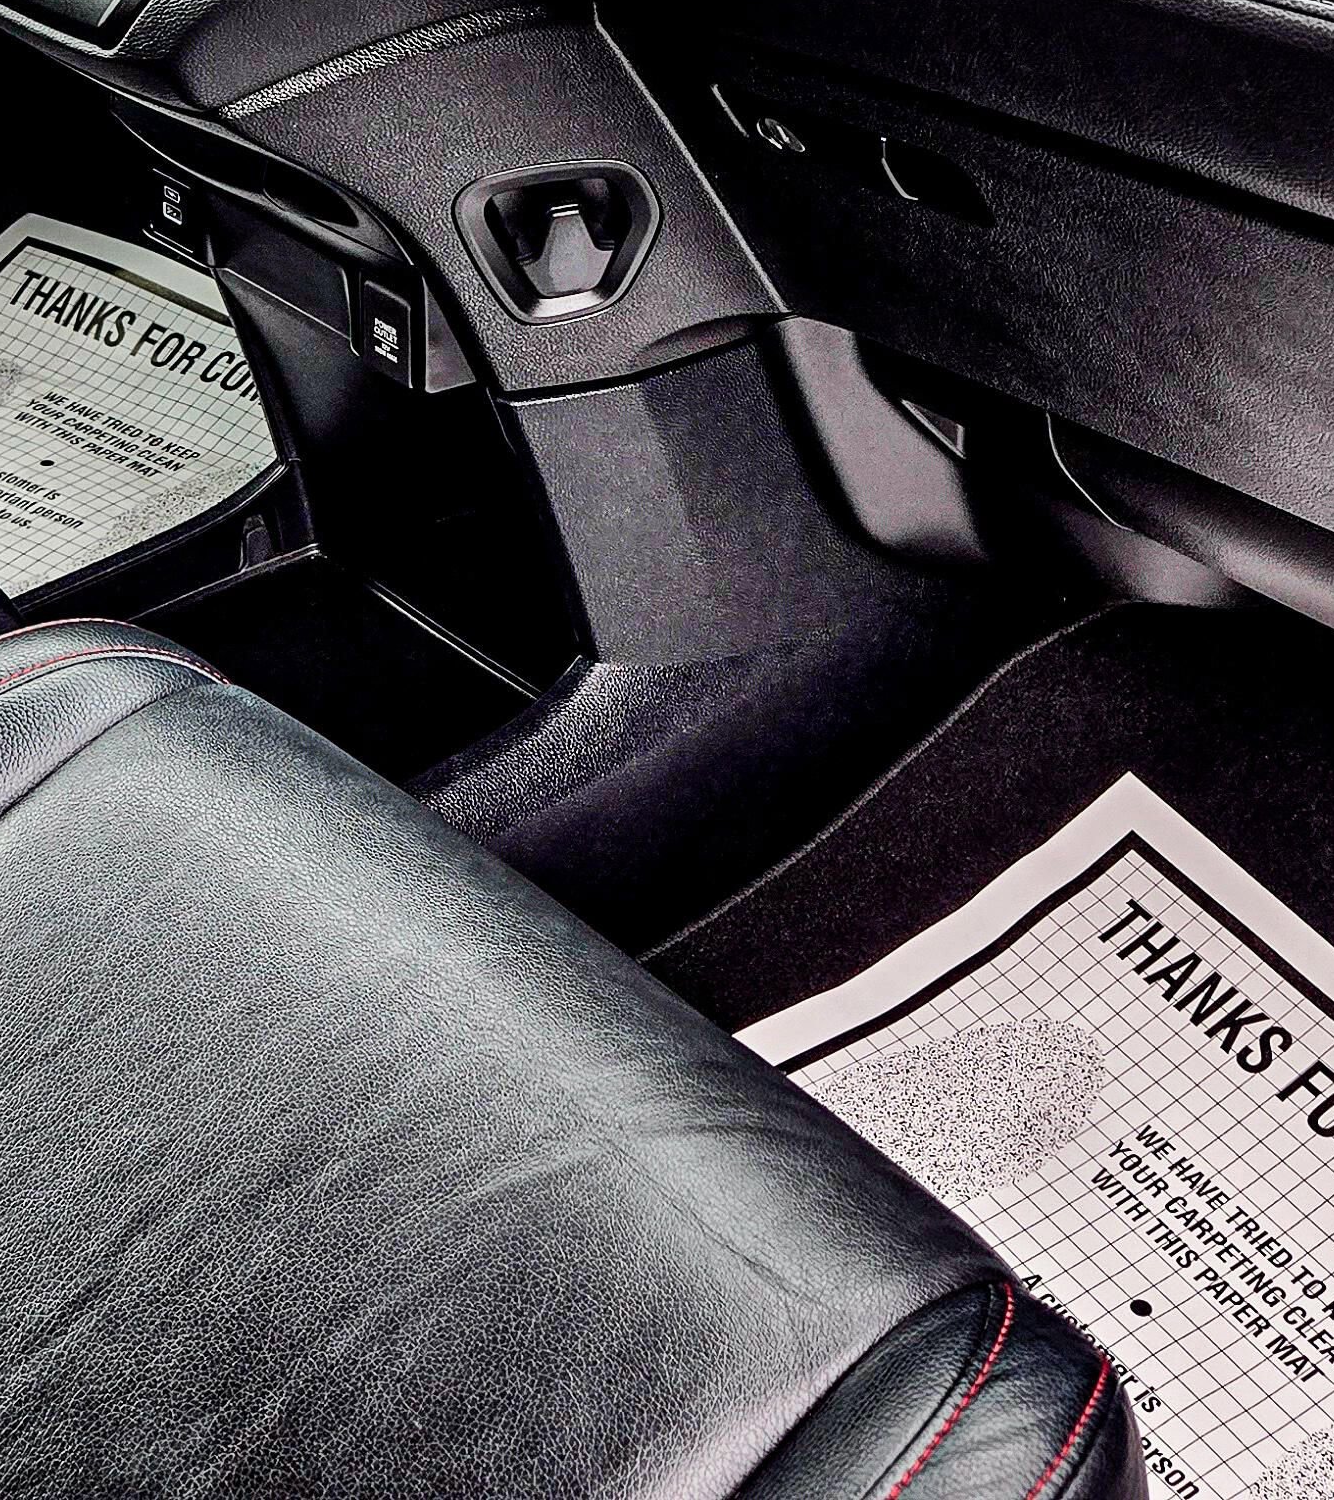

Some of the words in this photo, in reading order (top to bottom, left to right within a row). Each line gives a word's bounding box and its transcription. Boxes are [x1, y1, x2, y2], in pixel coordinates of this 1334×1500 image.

[9, 269, 136, 347] THANKS
[130, 322, 207, 375] FOR
[373, 325, 398, 344] OUTLET
[374, 317, 397, 336] POWER
[14, 411, 51, 430] WITH
[51, 426, 85, 445] THIS
[81, 442, 129, 465] PAPER
[126, 460, 163, 479] MAT
[26, 399, 65, 420] YOUR
[62, 417, 139, 454] CARPETING
[137, 449, 186, 473] CLEAN
[43, 391, 69, 406] WE
[65, 401, 104, 421] HAVE
[102, 416, 143, 438] TRIED
[142, 433, 164, 447] TO
[162, 442, 201, 461] KEEP
[11, 516, 33, 530] us.
[31, 504, 84, 530] person
[43, 489, 61, 501] is
[1097, 898, 1294, 1074] THANKS
[1108, 1139, 1169, 1198] YOUR
[1164, 1195, 1287, 1309] CARPETING
[1135, 1124, 1177, 1161] WE
[1168, 1156, 1231, 1211] HAVE
[1225, 1205, 1294, 1269] TRIED
[1291, 1265, 1327, 1300] TO
[1091, 1167, 1152, 1222] WITH
[1145, 1217, 1200, 1269] THIS
[1193, 1266, 1272, 1339] PAPER
[1265, 1333, 1326, 1384] MAT
[1021, 1274, 1042, 1292] A
[1133, 1386, 1162, 1414] is
[1139, 1436, 1201, 1500] erson
